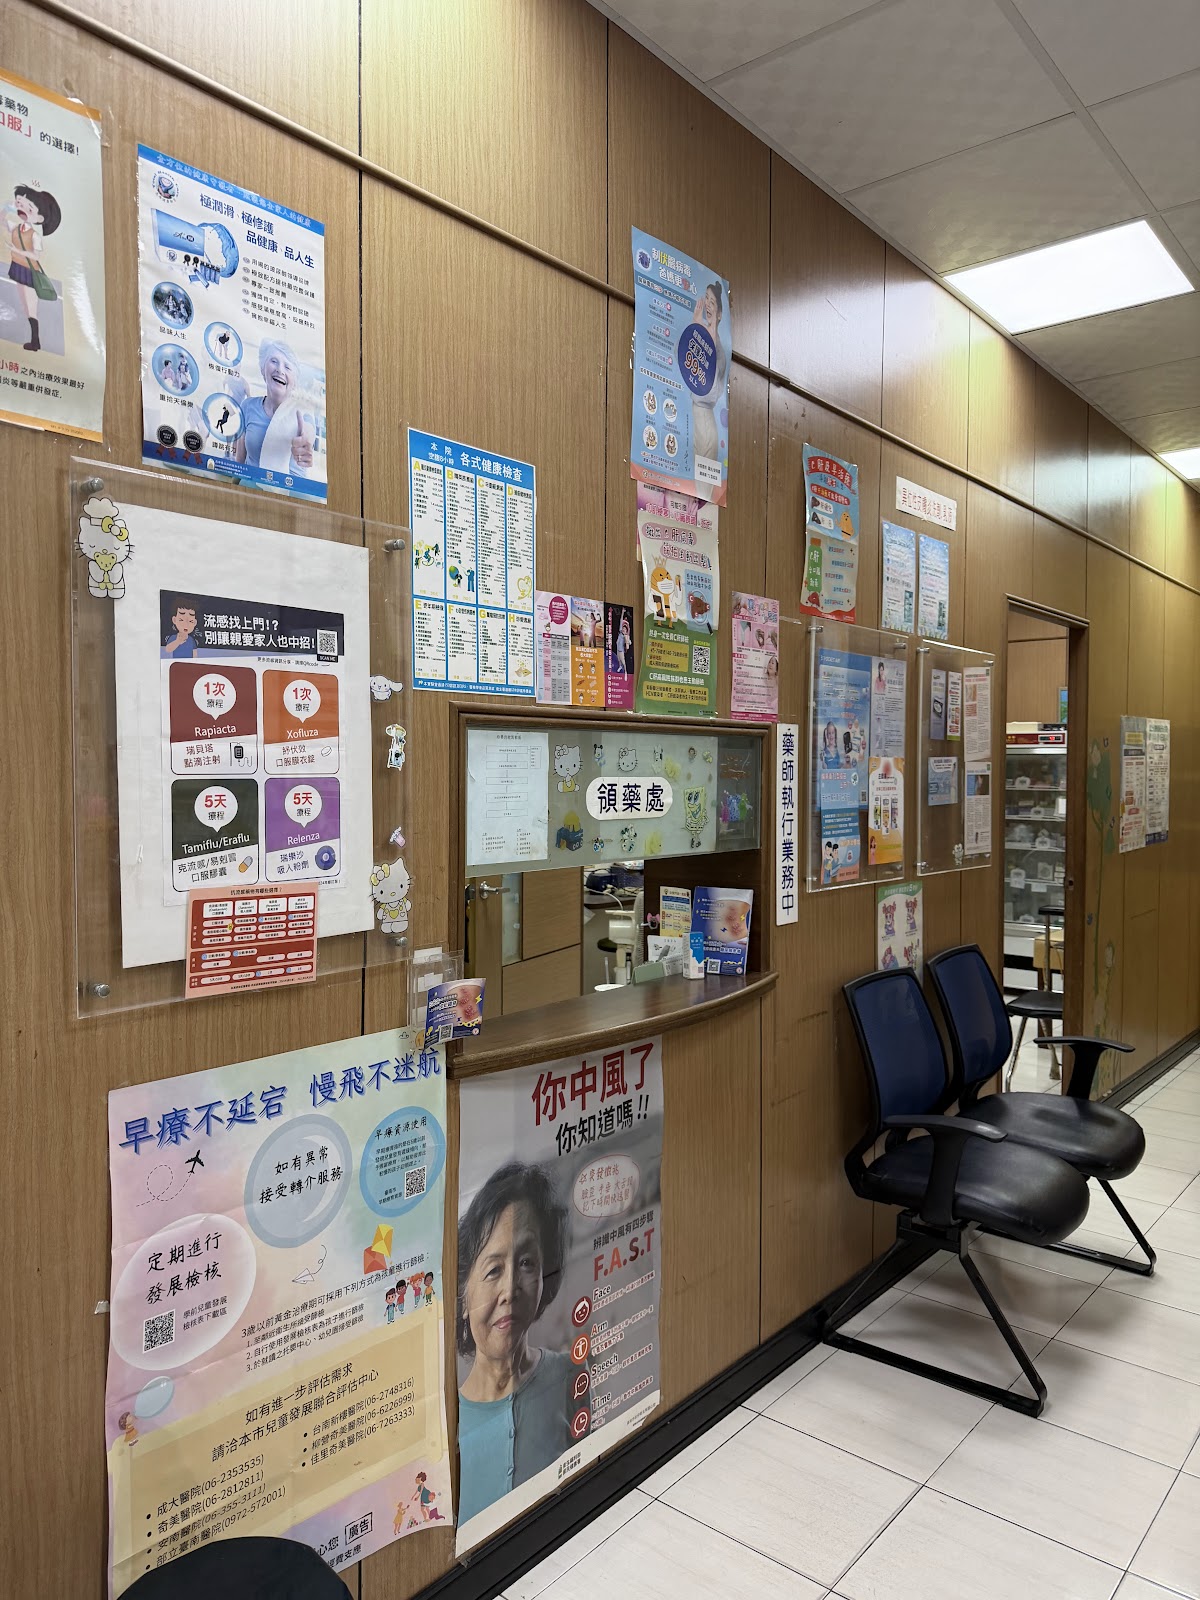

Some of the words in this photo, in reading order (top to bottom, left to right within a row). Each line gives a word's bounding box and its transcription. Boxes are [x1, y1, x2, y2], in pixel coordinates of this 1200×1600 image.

[0, 95, 29, 117] 藥物
[246, 230, 315, 269] 品健康、品人生
[413, 461, 421, 471] A
[446, 469, 454, 480] B
[460, 451, 523, 483] 各式健康檢查
[478, 478, 484, 488] C
[507, 486, 514, 496] D
[415, 600, 422, 610] E
[448, 605, 454, 614] F
[479, 609, 486, 619] G
[203, 613, 279, 631] 流感找上門!?
[508, 613, 515, 623] H
[204, 630, 315, 650] 別讓親愛家人也中招!
[204, 682, 226, 697] 1次
[292, 687, 312, 702] 1次
[206, 699, 224, 709] 療程
[295, 703, 310, 713] 療程
[194, 724, 237, 738] Rapiacta
[286, 728, 319, 740] Xofluza
[185, 743, 214, 755] 瑞貝塔
[183, 754, 221, 768] 點滴注射
[204, 793, 227, 809] 5天
[293, 792, 313, 806] 5天
[597, 782, 665, 814] 領藥處
[207, 811, 225, 821] 療程
[780, 731, 795, 916] 藥師執行業務中
[181, 832, 250, 856] Tamiflu/Eraflu
[287, 832, 320, 847] Relenza
[279, 850, 305, 863] 瑞樂沙
[191, 867, 228, 883] 口服膠囊
[276, 861, 310, 875] 吸入粉劑
[309, 1049, 442, 1108] 慢飛不迷航
[531, 1042, 654, 1127] 你中風了
[119, 1084, 288, 1154] 早療不延宕
[555, 1094, 650, 1156] 你知道嗎!!
[275, 1146, 329, 1176] 如有異常
[259, 1166, 343, 1204] 接受轉介服務
[593, 1209, 654, 1251] 辨識中風有四步驟
[146, 1231, 223, 1275] 定期進行
[593, 1227, 655, 1282] F.A.S.T
[145, 1261, 222, 1305] 發展檢核
[593, 1285, 611, 1301] Face
[183, 1295, 228, 1319] 學前兒童發展
[182, 1306, 228, 1331] 檢核表下載區
[591, 1320, 608, 1337] Arm
[591, 1353, 618, 1377] Speech
[245, 1363, 353, 1425] 如有進一步評估需求
[592, 1392, 611, 1411] Time
[211, 1369, 379, 1462] 請洽本市兒童發展聯合評估中心
[156, 1454, 265, 1518] 成大醫院(06-2353535)
[157, 1470, 264, 1534] 奇美醫院(06-2812811)
[349, 1518, 370, 1540] 廣告
